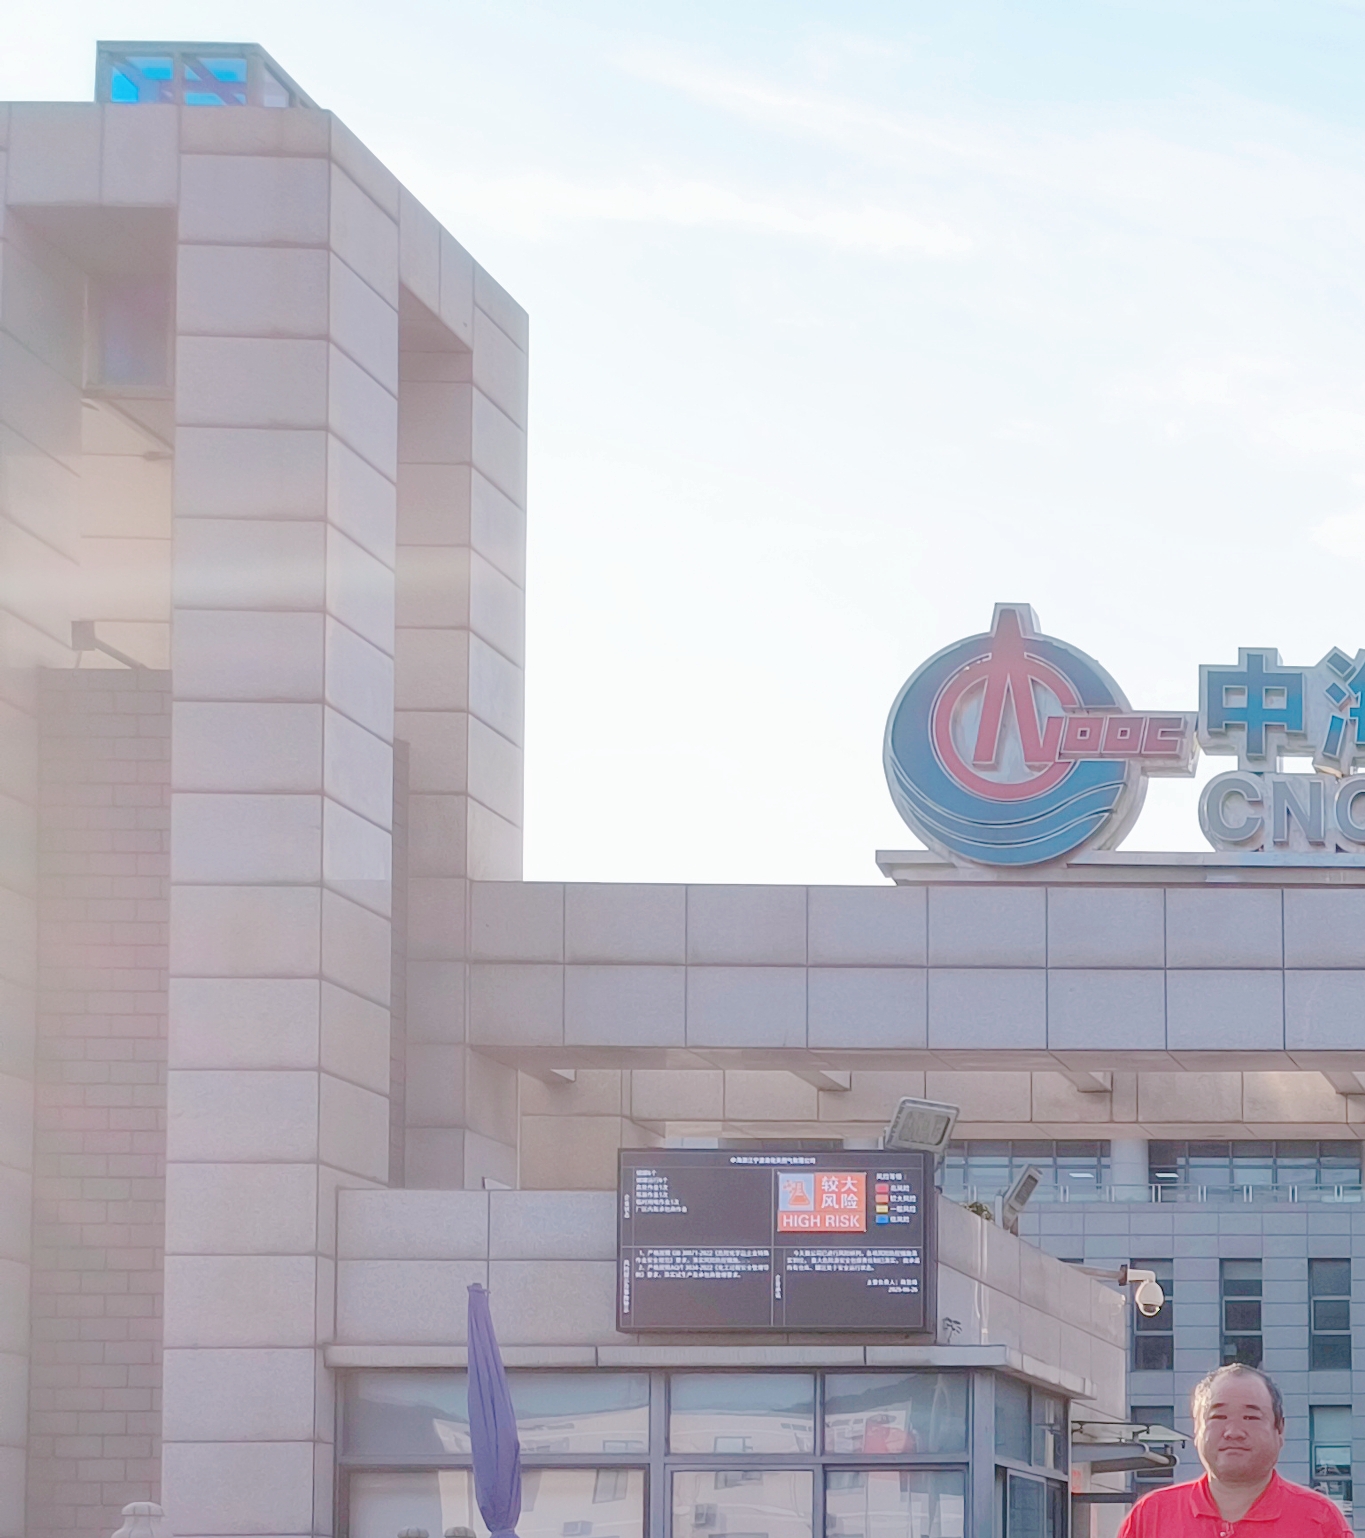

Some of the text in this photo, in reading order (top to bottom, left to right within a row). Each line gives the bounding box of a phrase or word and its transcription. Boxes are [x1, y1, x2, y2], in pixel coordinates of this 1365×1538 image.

[821, 1176, 858, 1192] 较大
[821, 1193, 858, 1209] 风险
[782, 1214, 860, 1228] HIGH RISK
